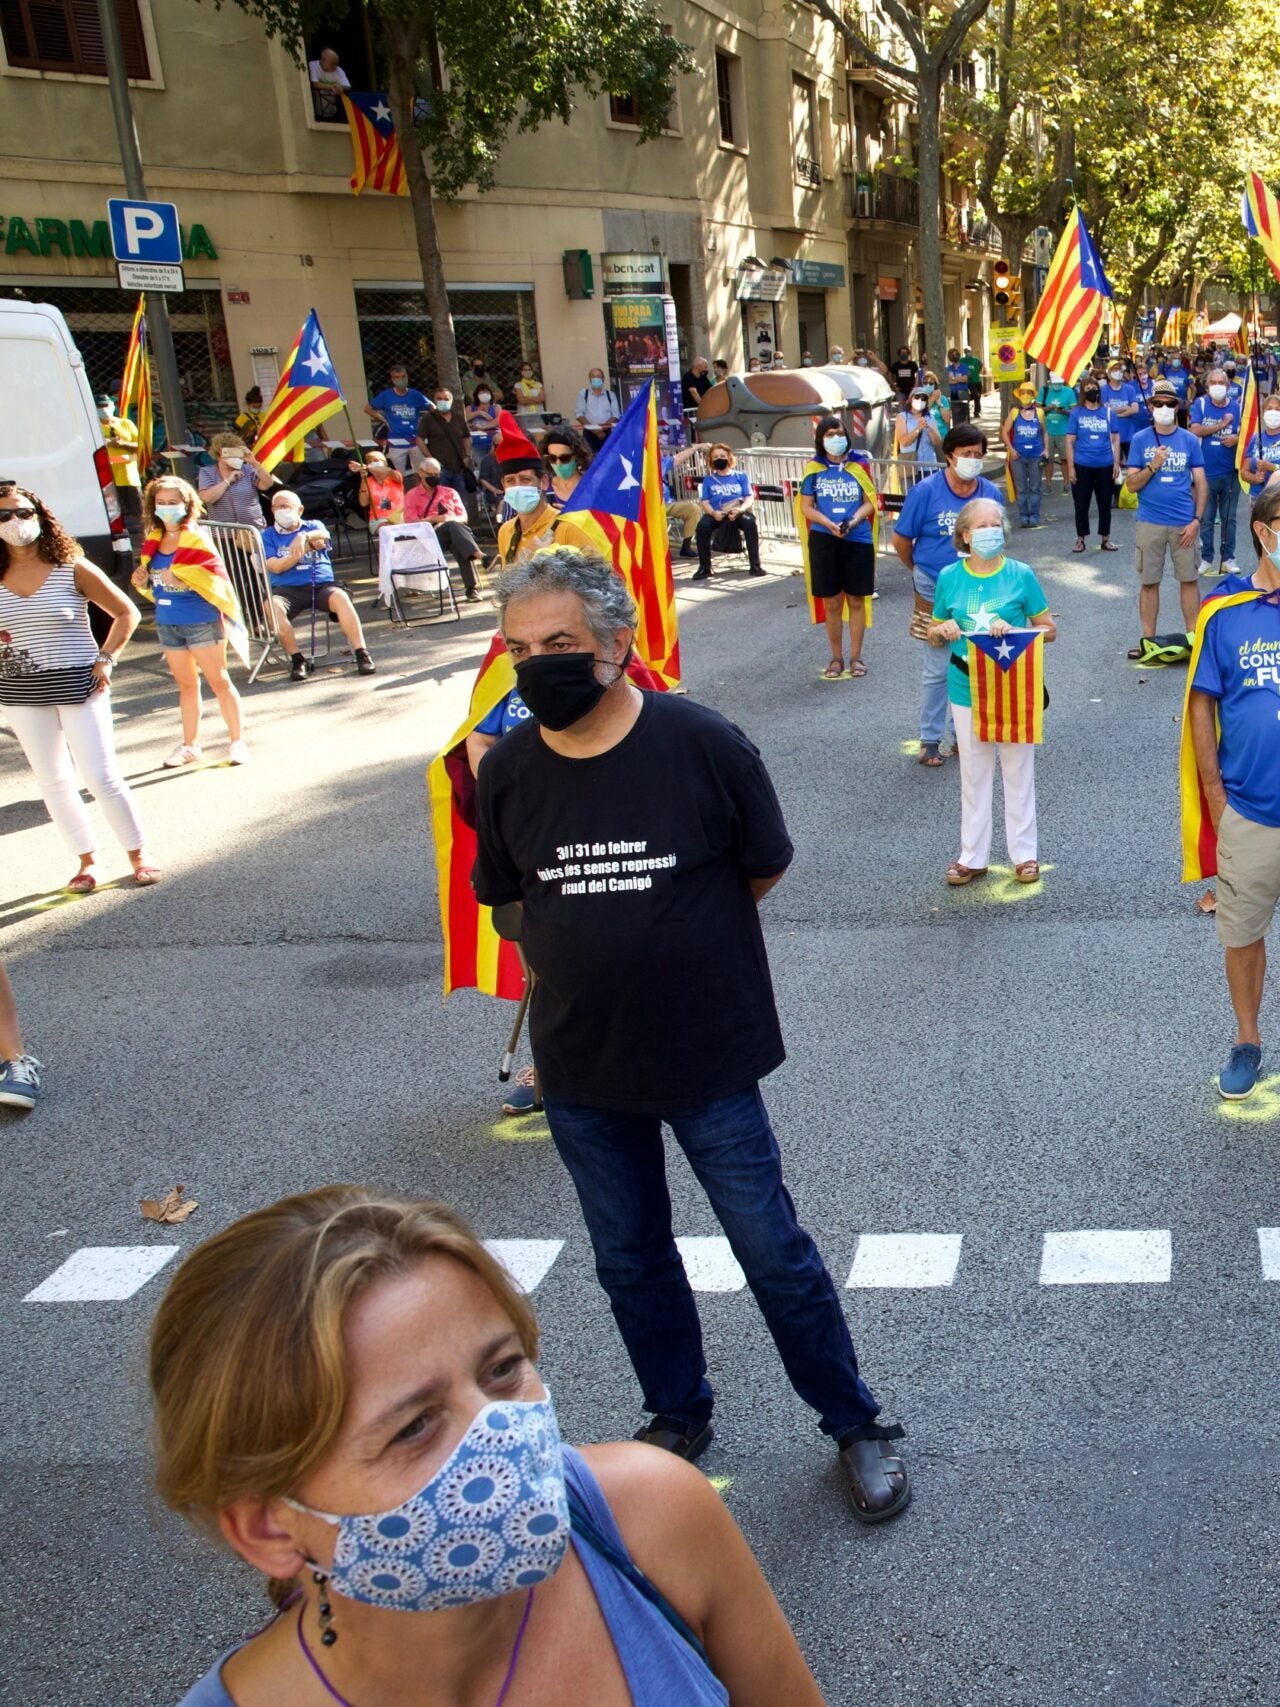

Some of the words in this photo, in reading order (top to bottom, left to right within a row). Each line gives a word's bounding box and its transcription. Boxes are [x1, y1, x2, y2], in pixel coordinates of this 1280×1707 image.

[123, 207, 164, 254] P
[823, 488, 859, 496] FUTUR
[1239, 640, 1250, 656] el
[575, 843, 590, 857] 31
[592, 842, 606, 856] de
[608, 840, 647, 854] febrer
[584, 860, 619, 875] sense
[588, 878, 606, 893] del
[609, 875, 652, 891] Canigó
